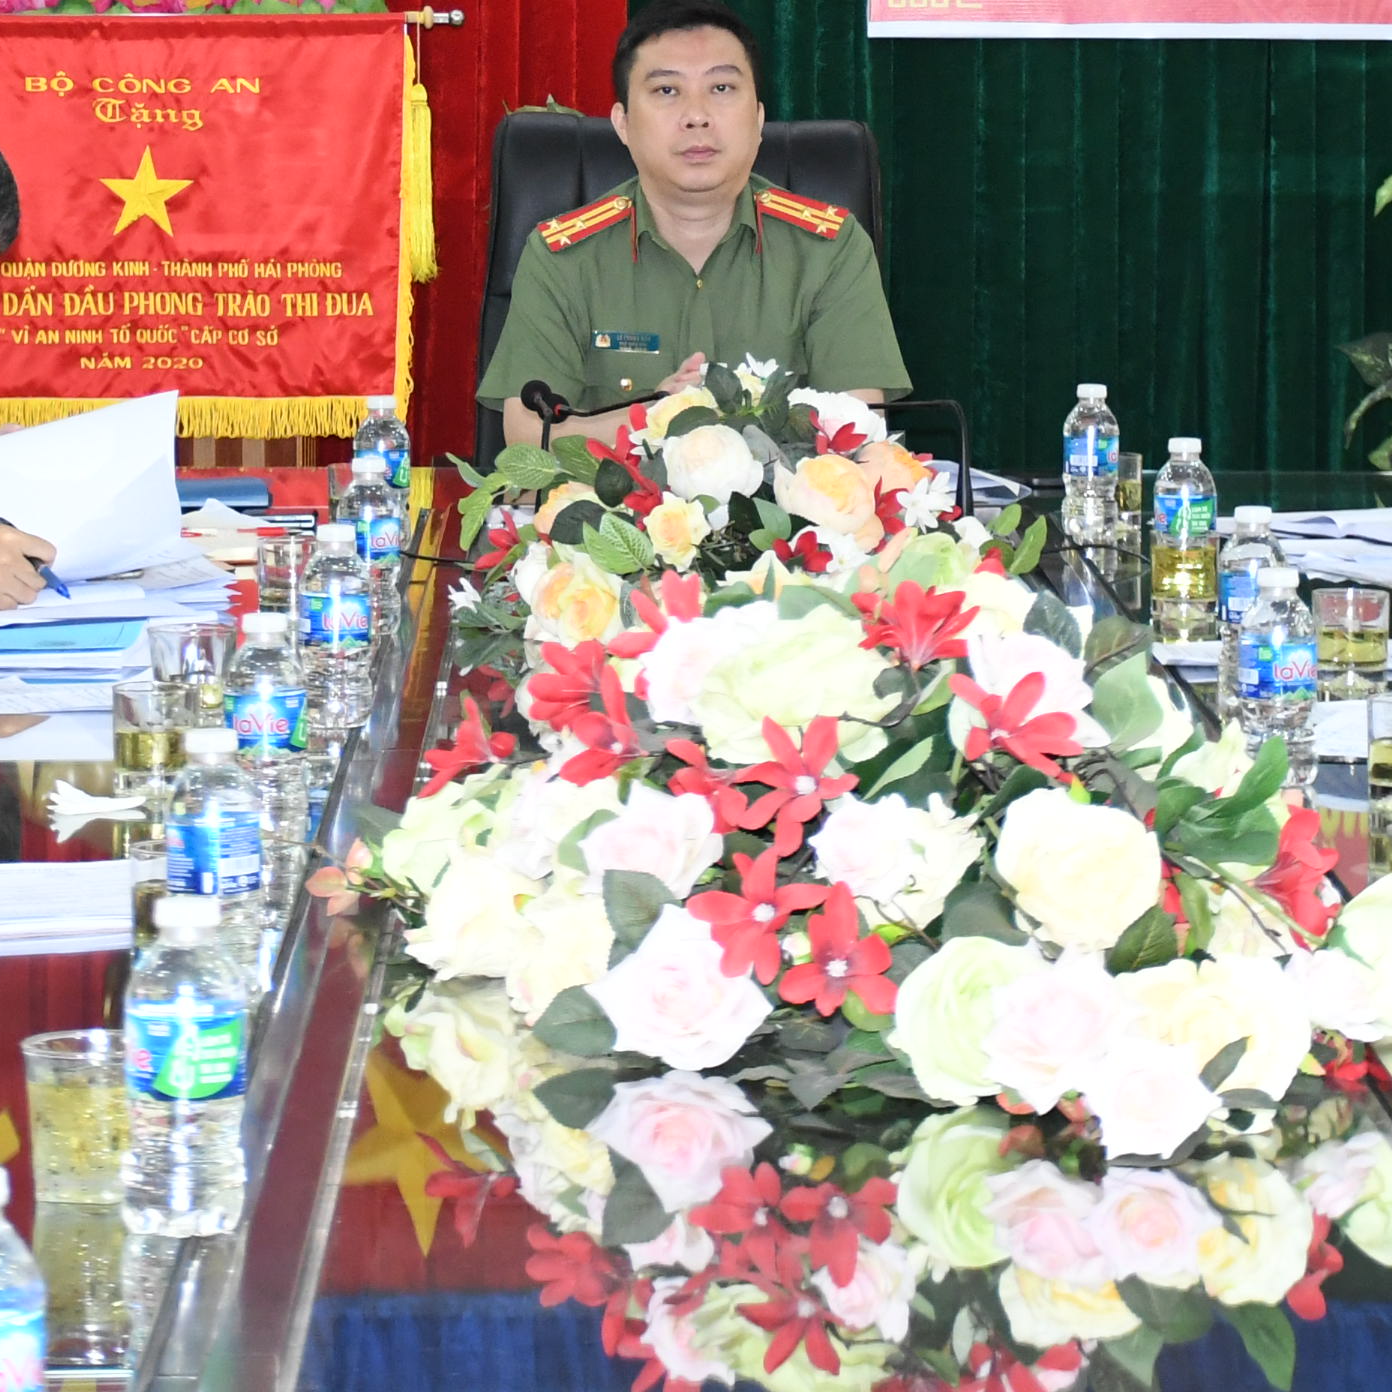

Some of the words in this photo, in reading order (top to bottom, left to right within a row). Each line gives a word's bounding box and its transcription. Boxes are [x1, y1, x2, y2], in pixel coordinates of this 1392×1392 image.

[25, 71, 74, 96] BỘ
[92, 73, 191, 93] CÔNG
[210, 78, 260, 93] AN
[93, 98, 203, 130] Tặng
[0, 258, 45, 279] QUẬN
[52, 260, 106, 277] DƯƠNG
[112, 261, 149, 276] KINH
[162, 259, 212, 277] THÀNH
[218, 259, 249, 278] PHỐ
[287, 260, 342, 278] PHÒNG
[64, 284, 114, 316] ĐẦU
[123, 292, 203, 316] PHONG
[215, 290, 270, 317] TRÀO
[282, 293, 318, 317] THI
[326, 293, 374, 316] ĐUA
[35, 329, 59, 344] AN
[65, 329, 103, 344] NINH
[229, 328, 249, 345] CƠ
[80, 352, 131, 369] NĂM
[142, 357, 203, 369] 2020
